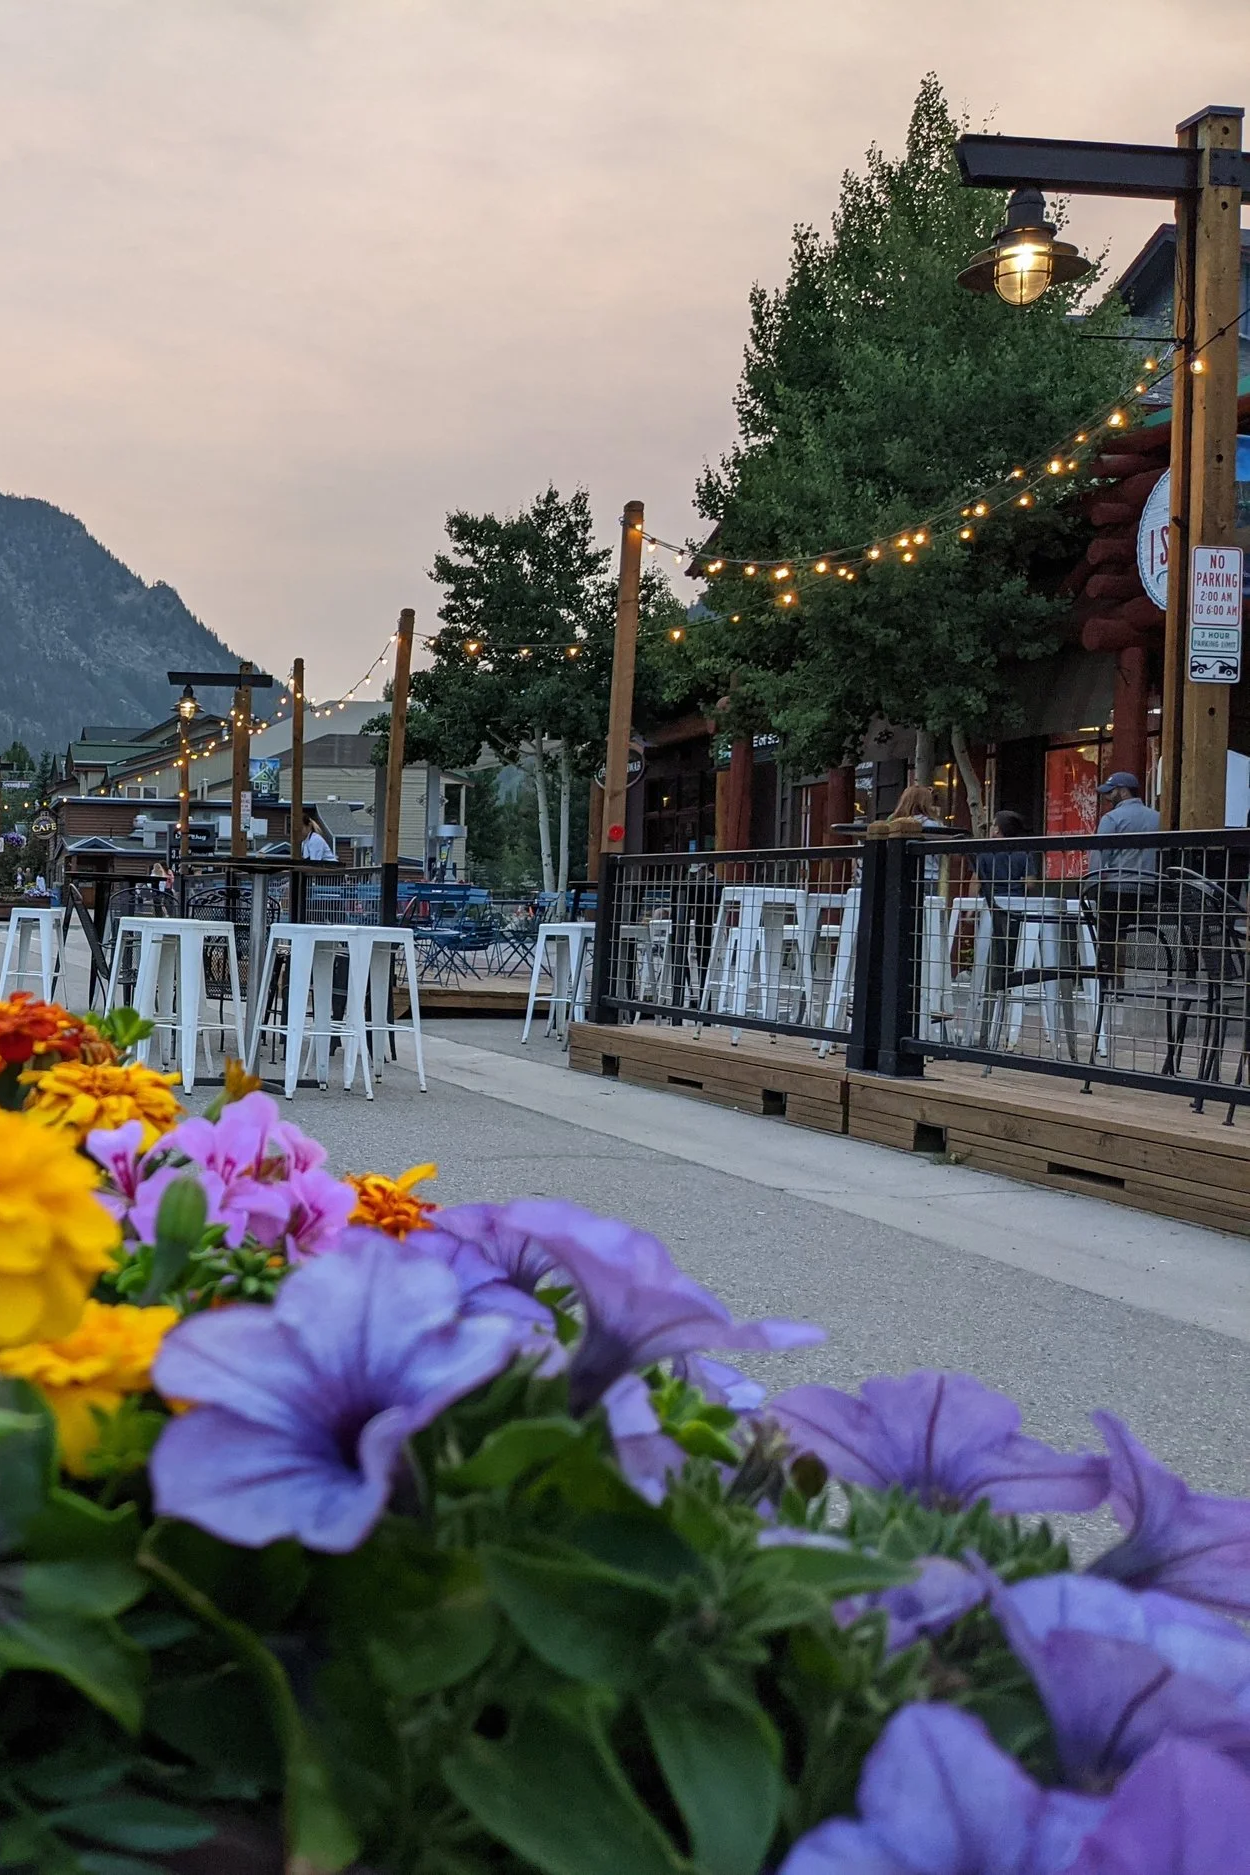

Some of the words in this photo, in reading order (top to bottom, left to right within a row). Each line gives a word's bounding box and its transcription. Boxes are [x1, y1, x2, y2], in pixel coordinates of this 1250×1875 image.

[1210, 554, 1225, 569] NO
[1196, 572, 1238, 588] PARKING
[1200, 591, 1219, 601] 2:00
[1221, 592, 1232, 602] AM
[1195, 604, 1204, 614] TO
[1206, 605, 1224, 615] 6:00
[1226, 606, 1238, 616] AM
[1193, 640, 1220, 648] PARKING
[1220, 641, 1237, 649] LIMIT
